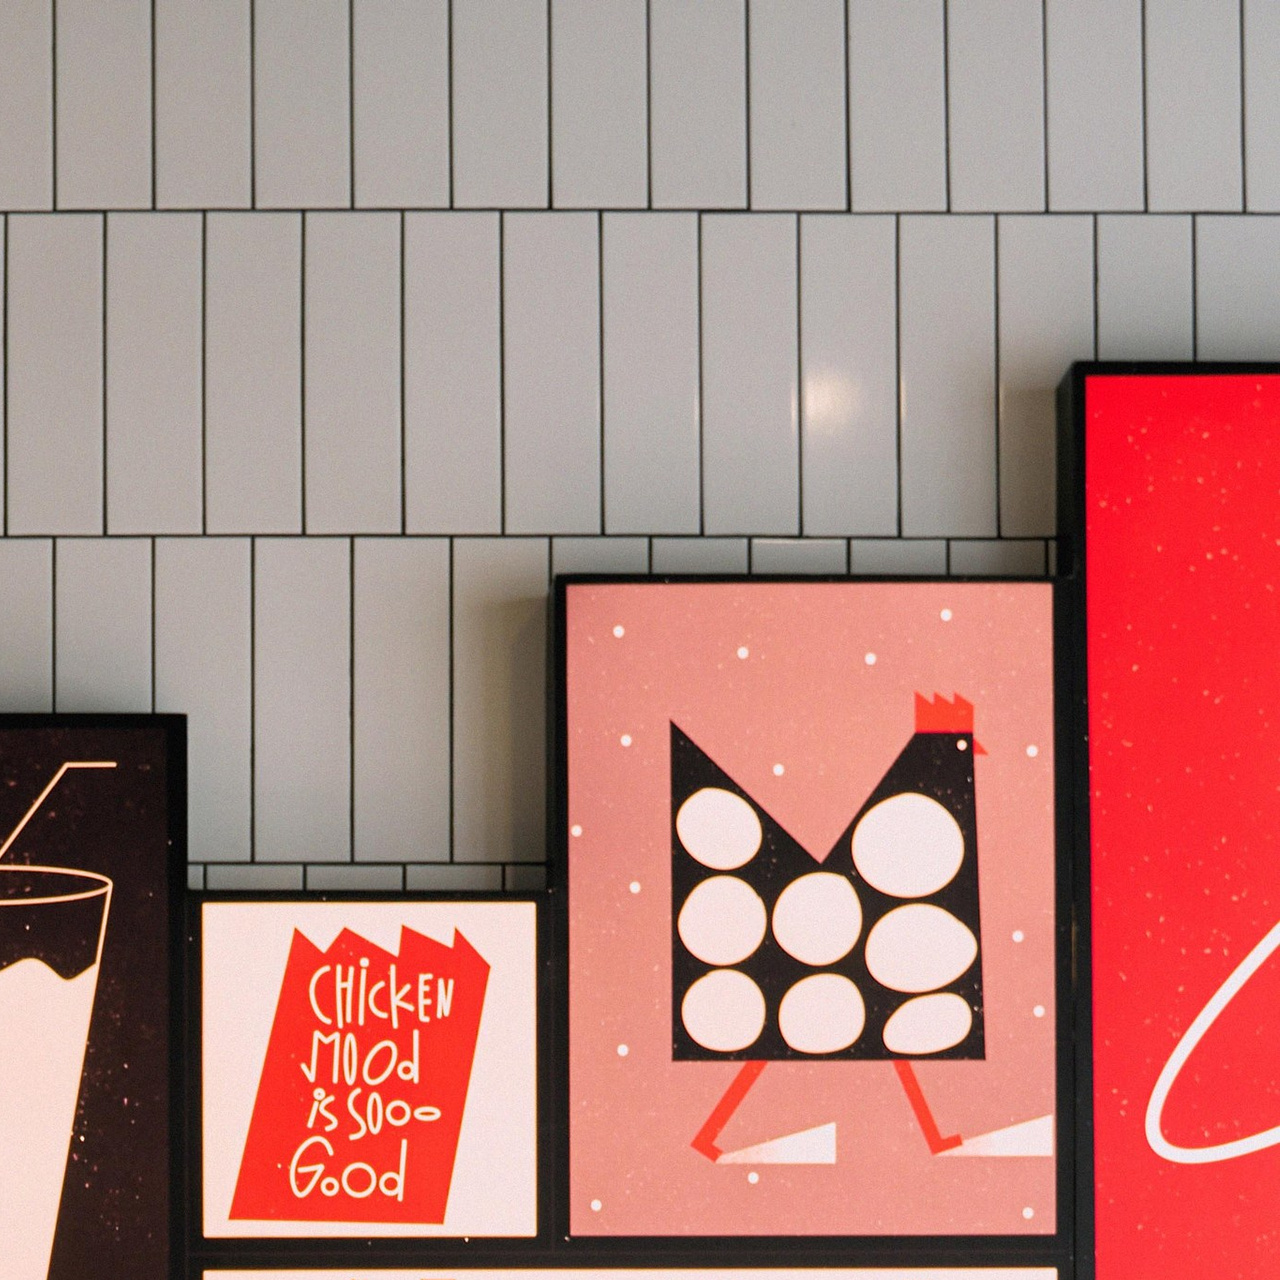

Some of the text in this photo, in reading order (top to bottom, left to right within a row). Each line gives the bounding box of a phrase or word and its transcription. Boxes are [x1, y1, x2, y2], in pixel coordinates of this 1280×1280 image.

[308, 957, 454, 1029] CHiCKEN
[300, 1028, 420, 1085] MOOd
[288, 1135, 408, 1203] GoOd
